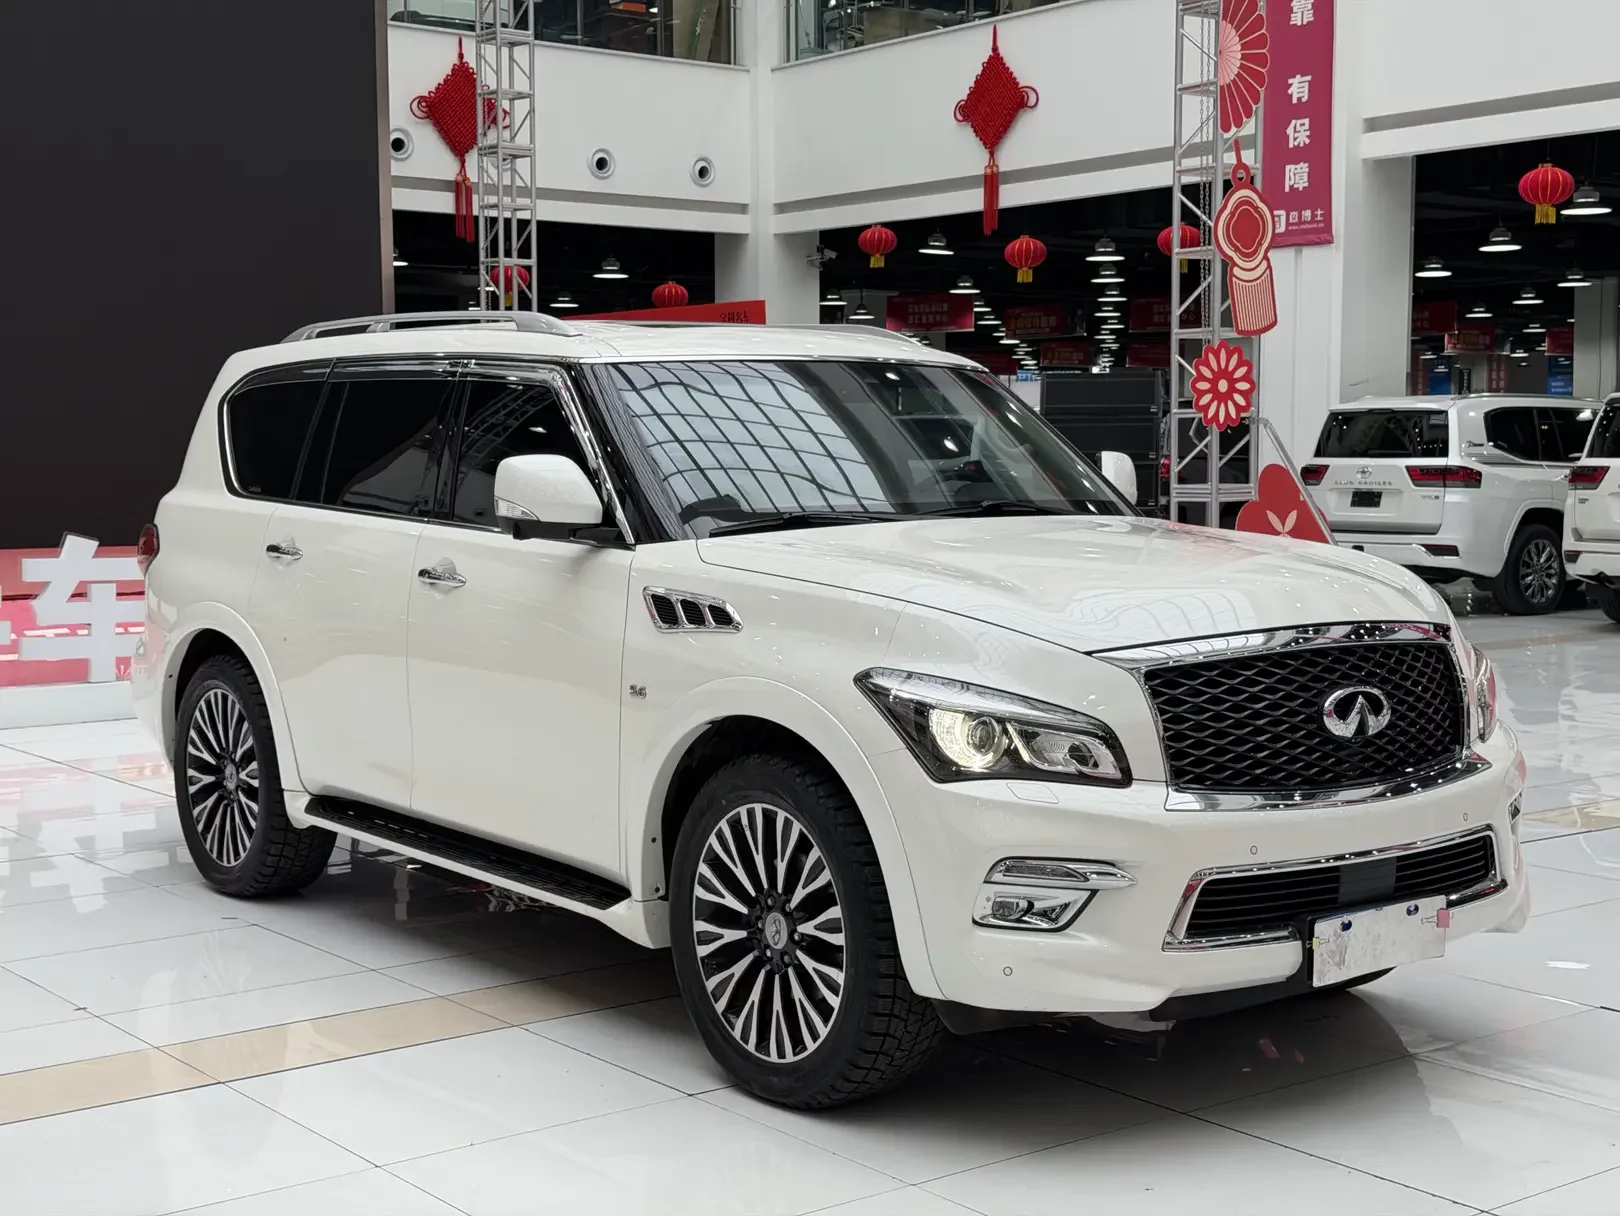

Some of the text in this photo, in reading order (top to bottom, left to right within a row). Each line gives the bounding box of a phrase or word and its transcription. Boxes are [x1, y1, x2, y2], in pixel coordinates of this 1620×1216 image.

[1285, 0, 1315, 193] 靠 有保障
